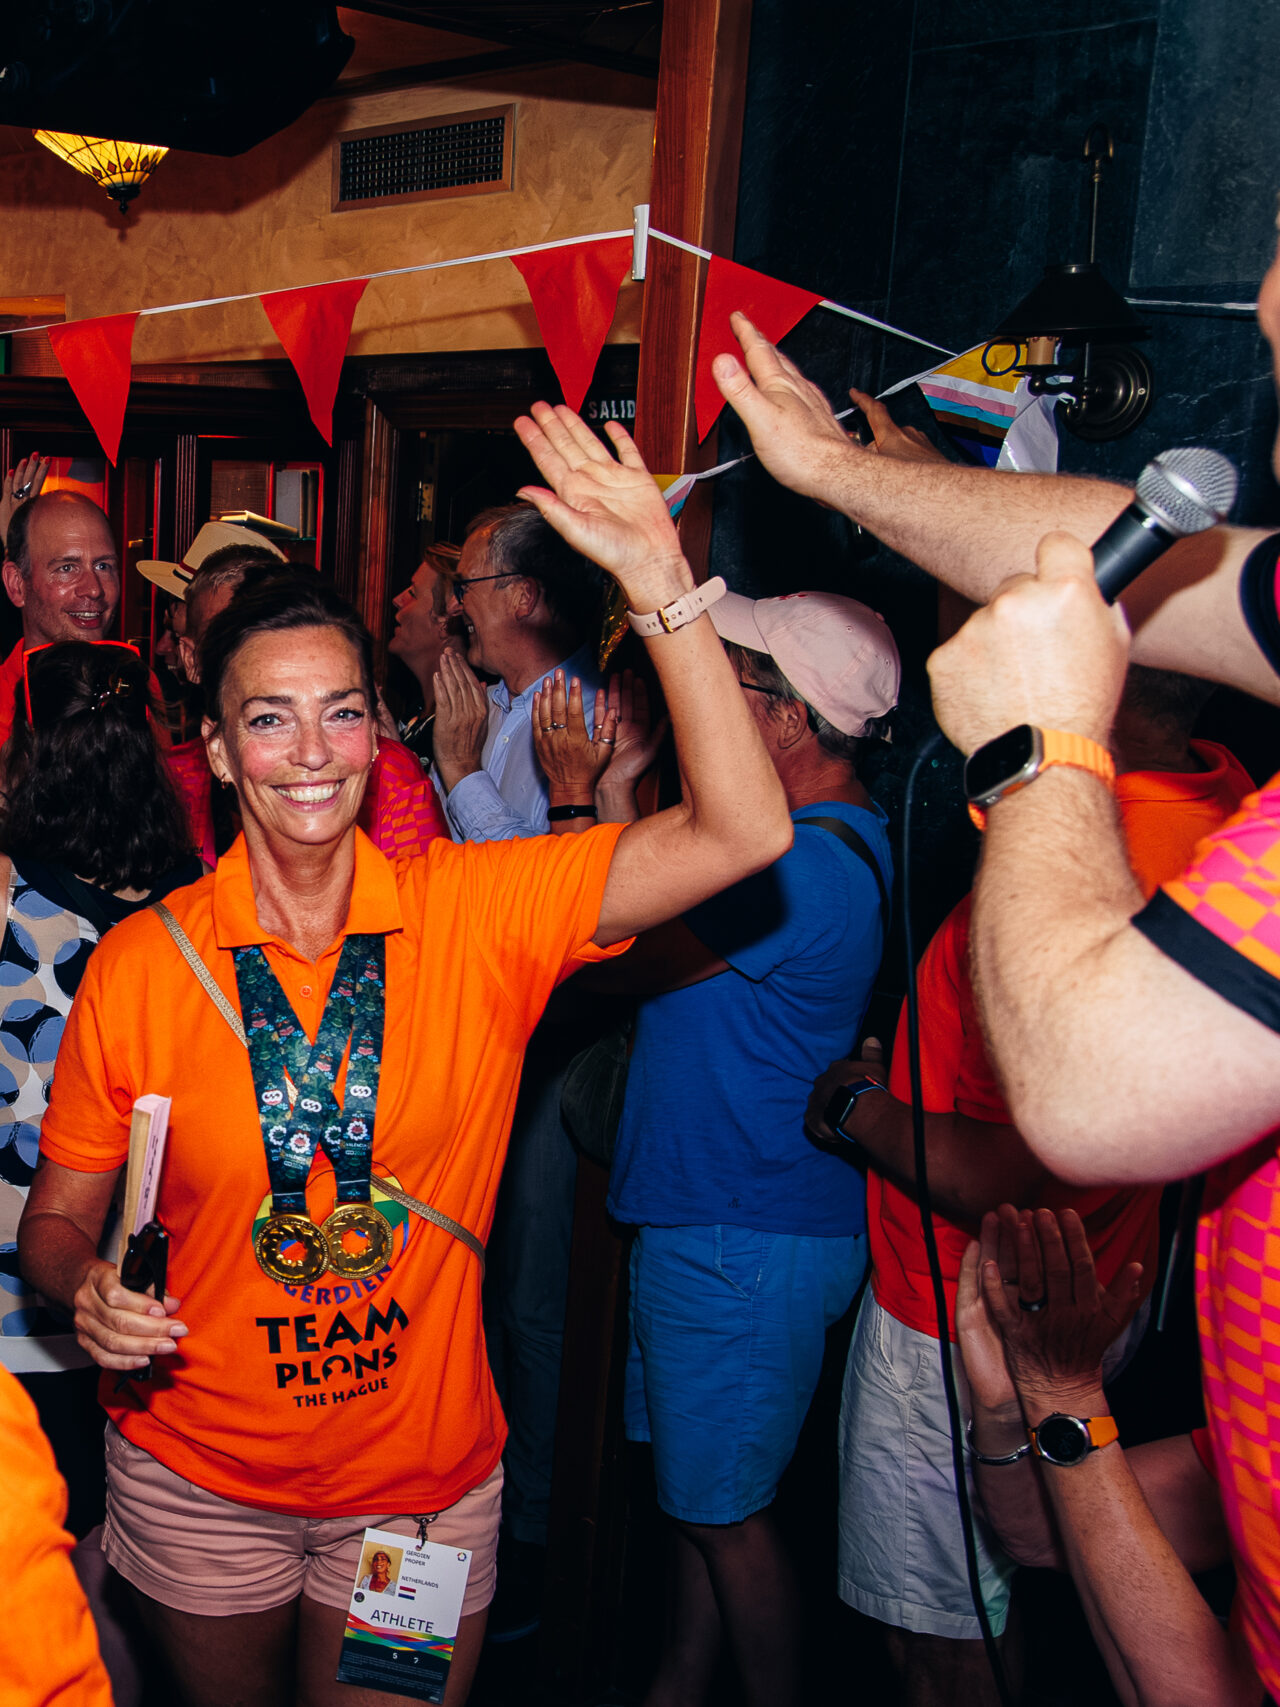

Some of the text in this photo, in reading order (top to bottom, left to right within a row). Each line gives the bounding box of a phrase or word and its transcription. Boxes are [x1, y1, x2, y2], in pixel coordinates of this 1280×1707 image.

[255, 1296, 410, 1354] TEAM
[275, 1342, 398, 1389] PLONS
[293, 1377, 389, 1408] THE HAGUE
[404, 1557, 426, 1567] PROPER
[406, 1550, 431, 1560] GERDIEN
[401, 1575, 439, 1589] NETHERLANDS
[370, 1609, 434, 1634] ATHLETE
